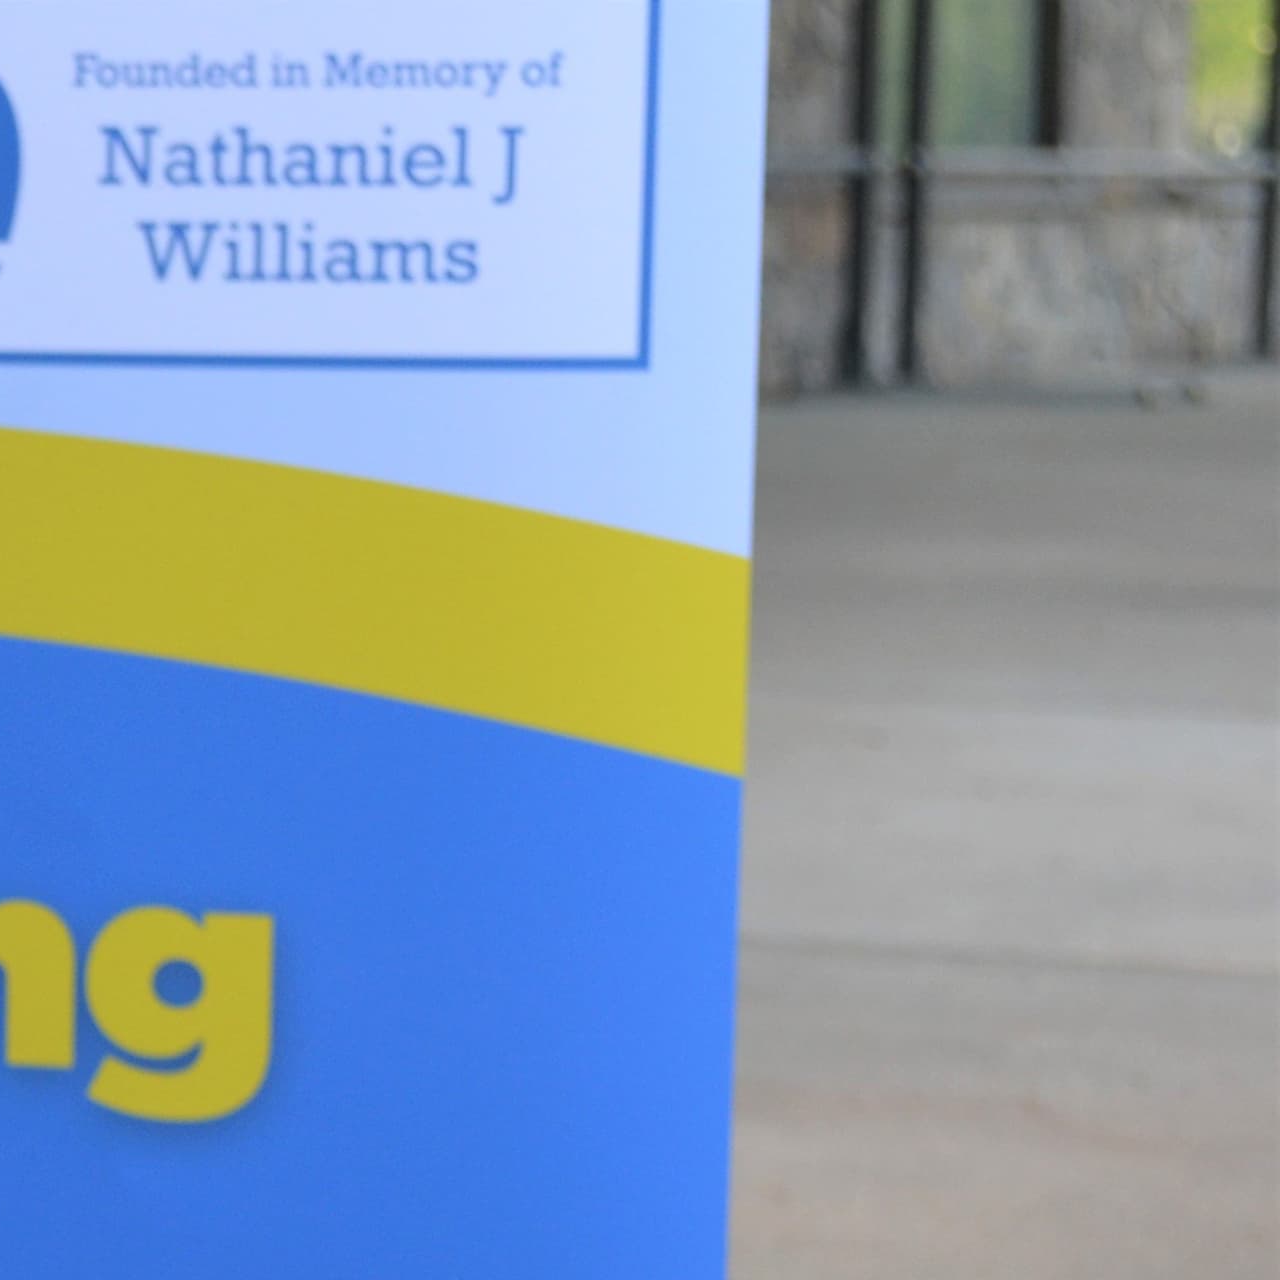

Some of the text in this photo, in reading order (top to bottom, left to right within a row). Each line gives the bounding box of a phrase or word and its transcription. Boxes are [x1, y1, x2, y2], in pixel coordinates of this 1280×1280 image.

[72, 52, 564, 97] Founded in Memory of
[98, 124, 525, 205] Nathaniel J
[137, 219, 480, 285] Williams
